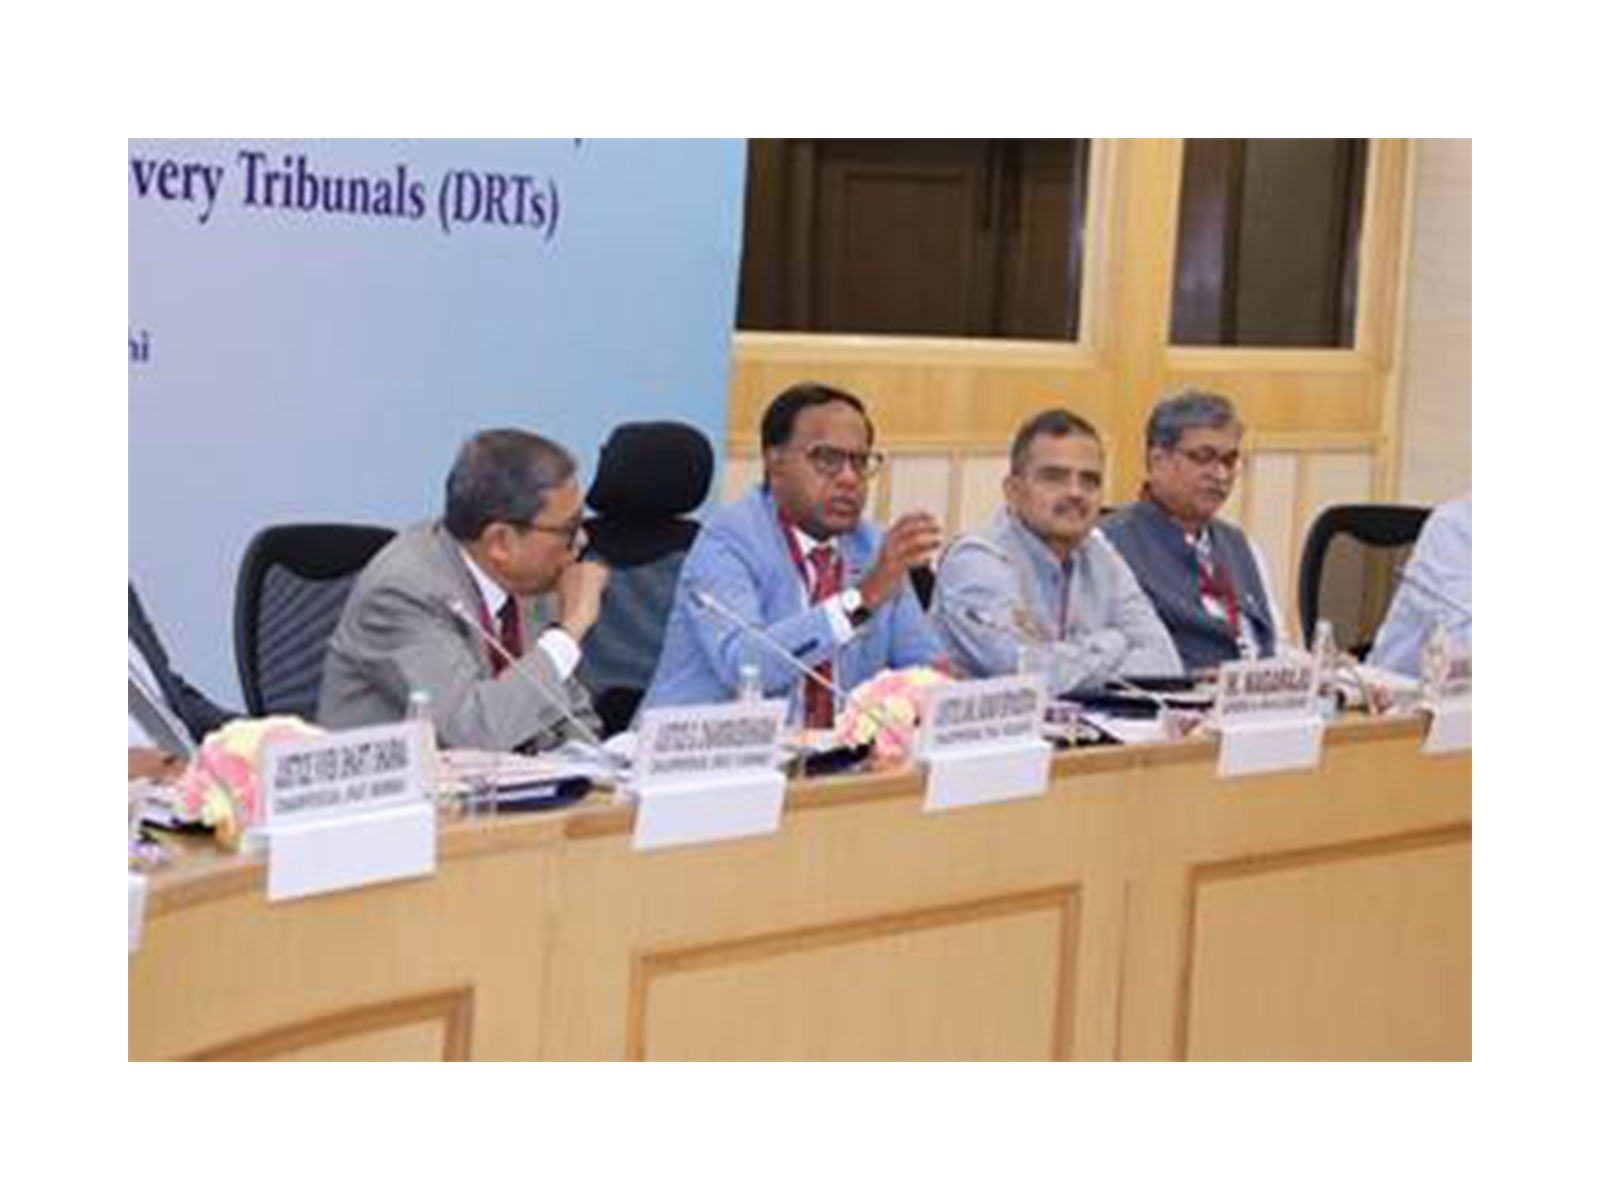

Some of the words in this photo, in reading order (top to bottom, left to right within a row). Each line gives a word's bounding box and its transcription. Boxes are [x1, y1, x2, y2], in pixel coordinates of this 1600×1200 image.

[131, 160, 224, 224] very
[237, 151, 426, 219] Tribunals
[438, 169, 559, 241] (DRTs)
